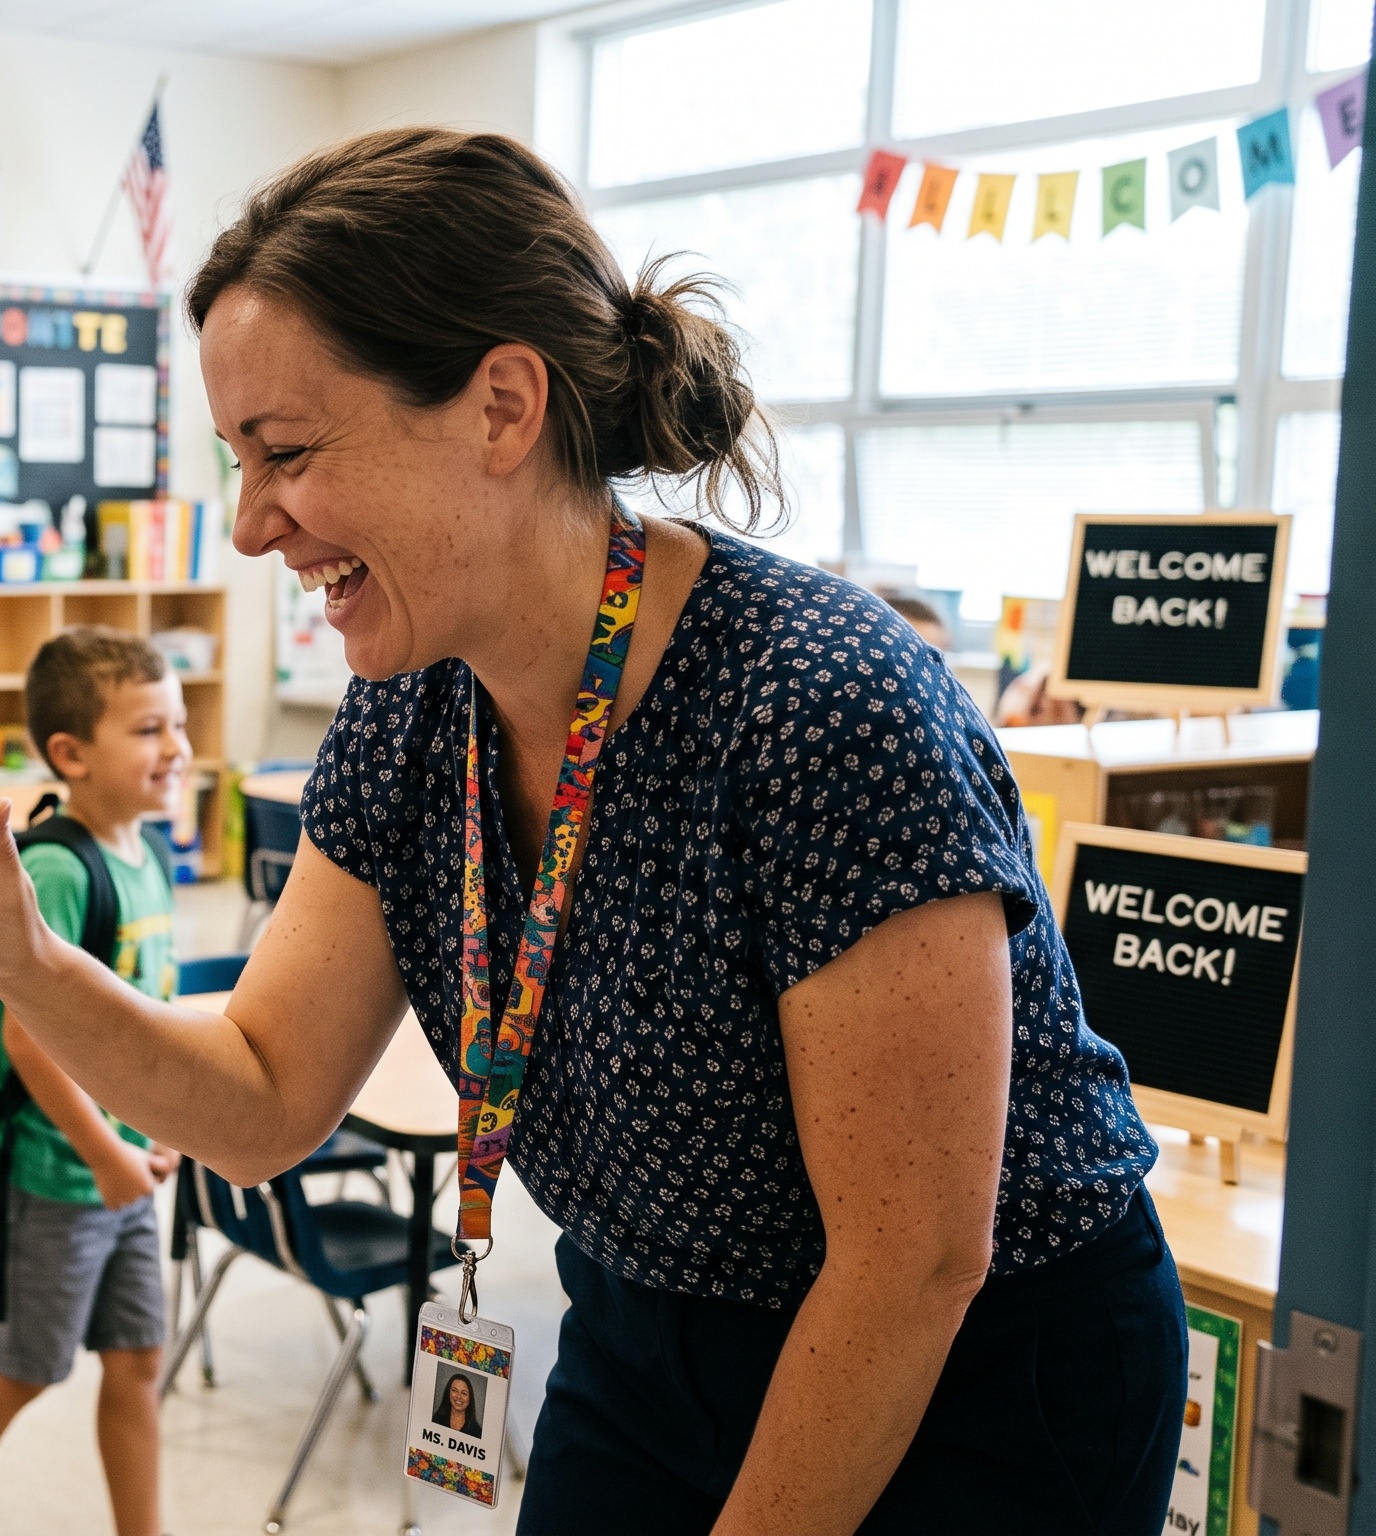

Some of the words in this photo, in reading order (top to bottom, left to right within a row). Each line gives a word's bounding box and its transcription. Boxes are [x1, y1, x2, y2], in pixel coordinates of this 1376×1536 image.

[1085, 549, 1267, 583] WELCOME
[1111, 595, 1229, 630] BACK!
[1084, 879, 1289, 943] WELCOME
[1112, 932, 1236, 987] BACK!
[421, 1428, 444, 1447] MS.
[447, 1437, 486, 1461] DAVIS
